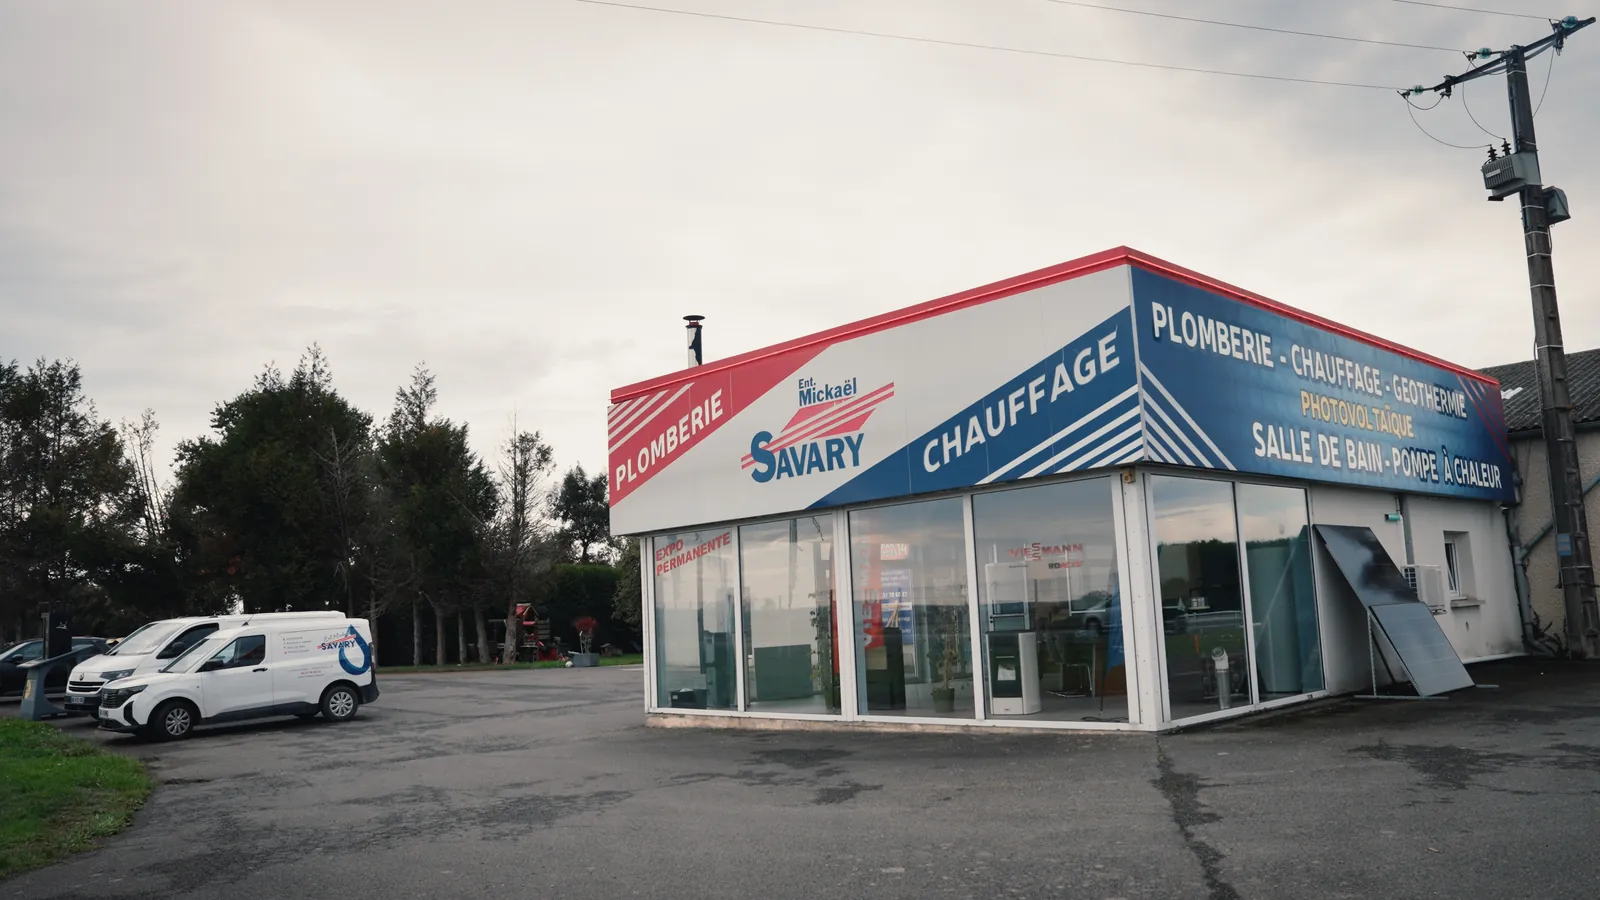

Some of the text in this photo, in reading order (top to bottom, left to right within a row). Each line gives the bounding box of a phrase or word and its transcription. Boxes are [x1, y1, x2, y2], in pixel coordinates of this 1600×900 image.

[798, 377, 816, 389] Ent.
[1152, 301, 1274, 368] PLOMBERIE
[1291, 344, 1383, 397] CHAUFFAGE
[1392, 374, 1468, 419] GEOTHERMIE
[799, 377, 857, 406] Mickaël
[922, 329, 1121, 473] CHAUFFAGE
[615, 388, 724, 491] PLOMBERIE
[751, 431, 864, 483] SAVARY
[1252, 421, 1311, 465] SALLE
[1318, 433, 1341, 468] DE
[1348, 438, 1384, 474] BAIN
[1392, 447, 1439, 482] POMPE
[1443, 446, 1453, 483] À
[1453, 458, 1503, 490] CHALEUR
[655, 539, 684, 562] EXPO
[656, 532, 731, 576] PERMANENTE
[321, 640, 355, 651] SAVARY
